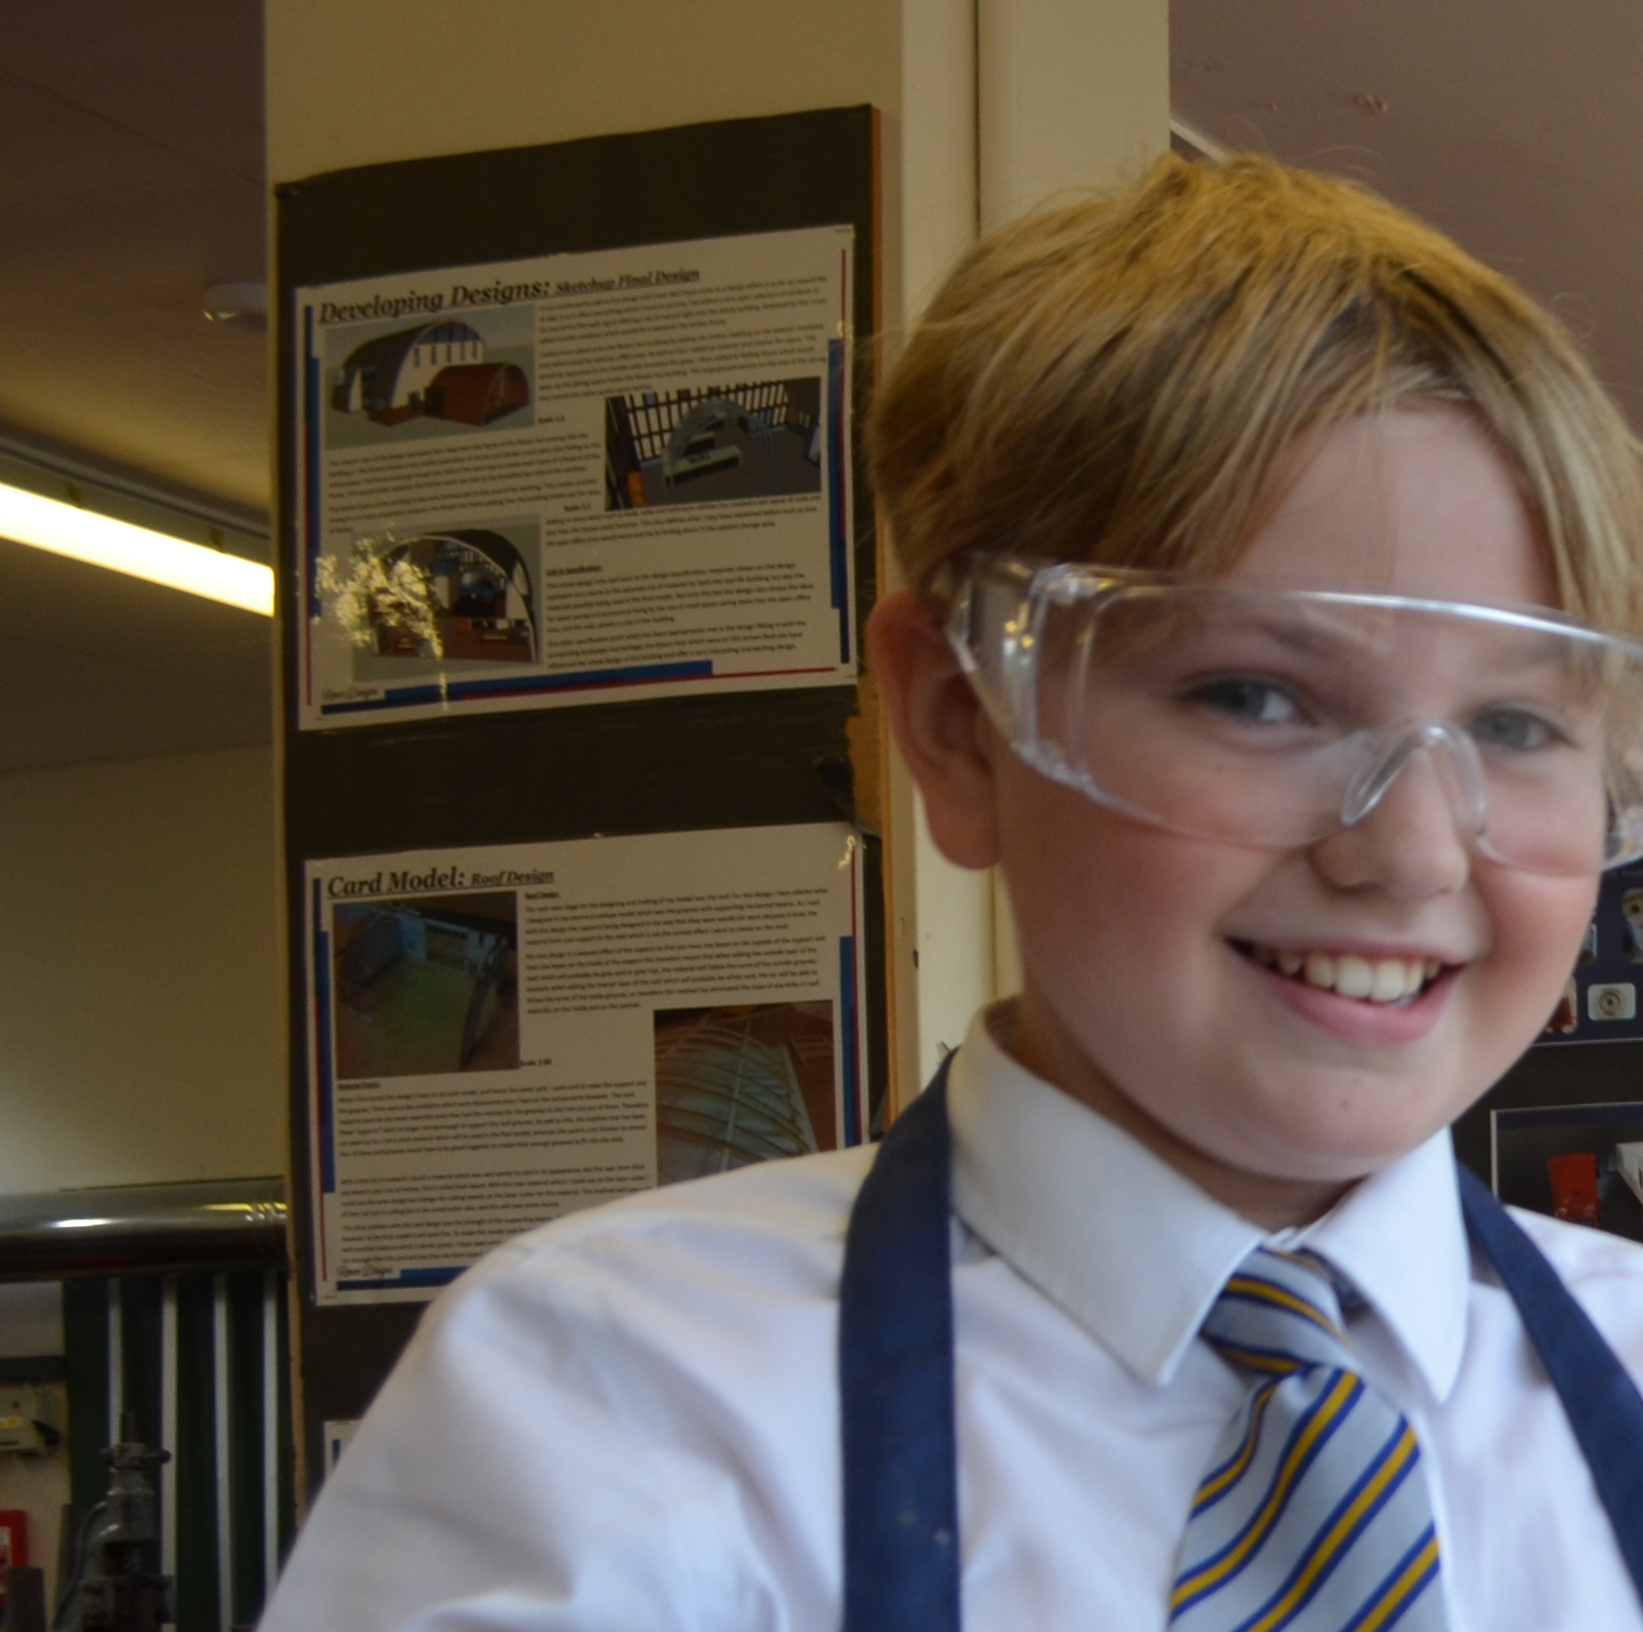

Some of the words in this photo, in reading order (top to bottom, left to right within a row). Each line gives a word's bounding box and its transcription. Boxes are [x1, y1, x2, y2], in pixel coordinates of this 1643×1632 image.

[319, 289, 444, 324] Developing
[451, 279, 550, 310] Designs:
[618, 271, 653, 288] Final
[655, 267, 701, 284] Design
[327, 872, 383, 897] Card
[387, 866, 466, 891] Model:
[471, 871, 506, 887] Roof
[507, 868, 554, 886] Design
